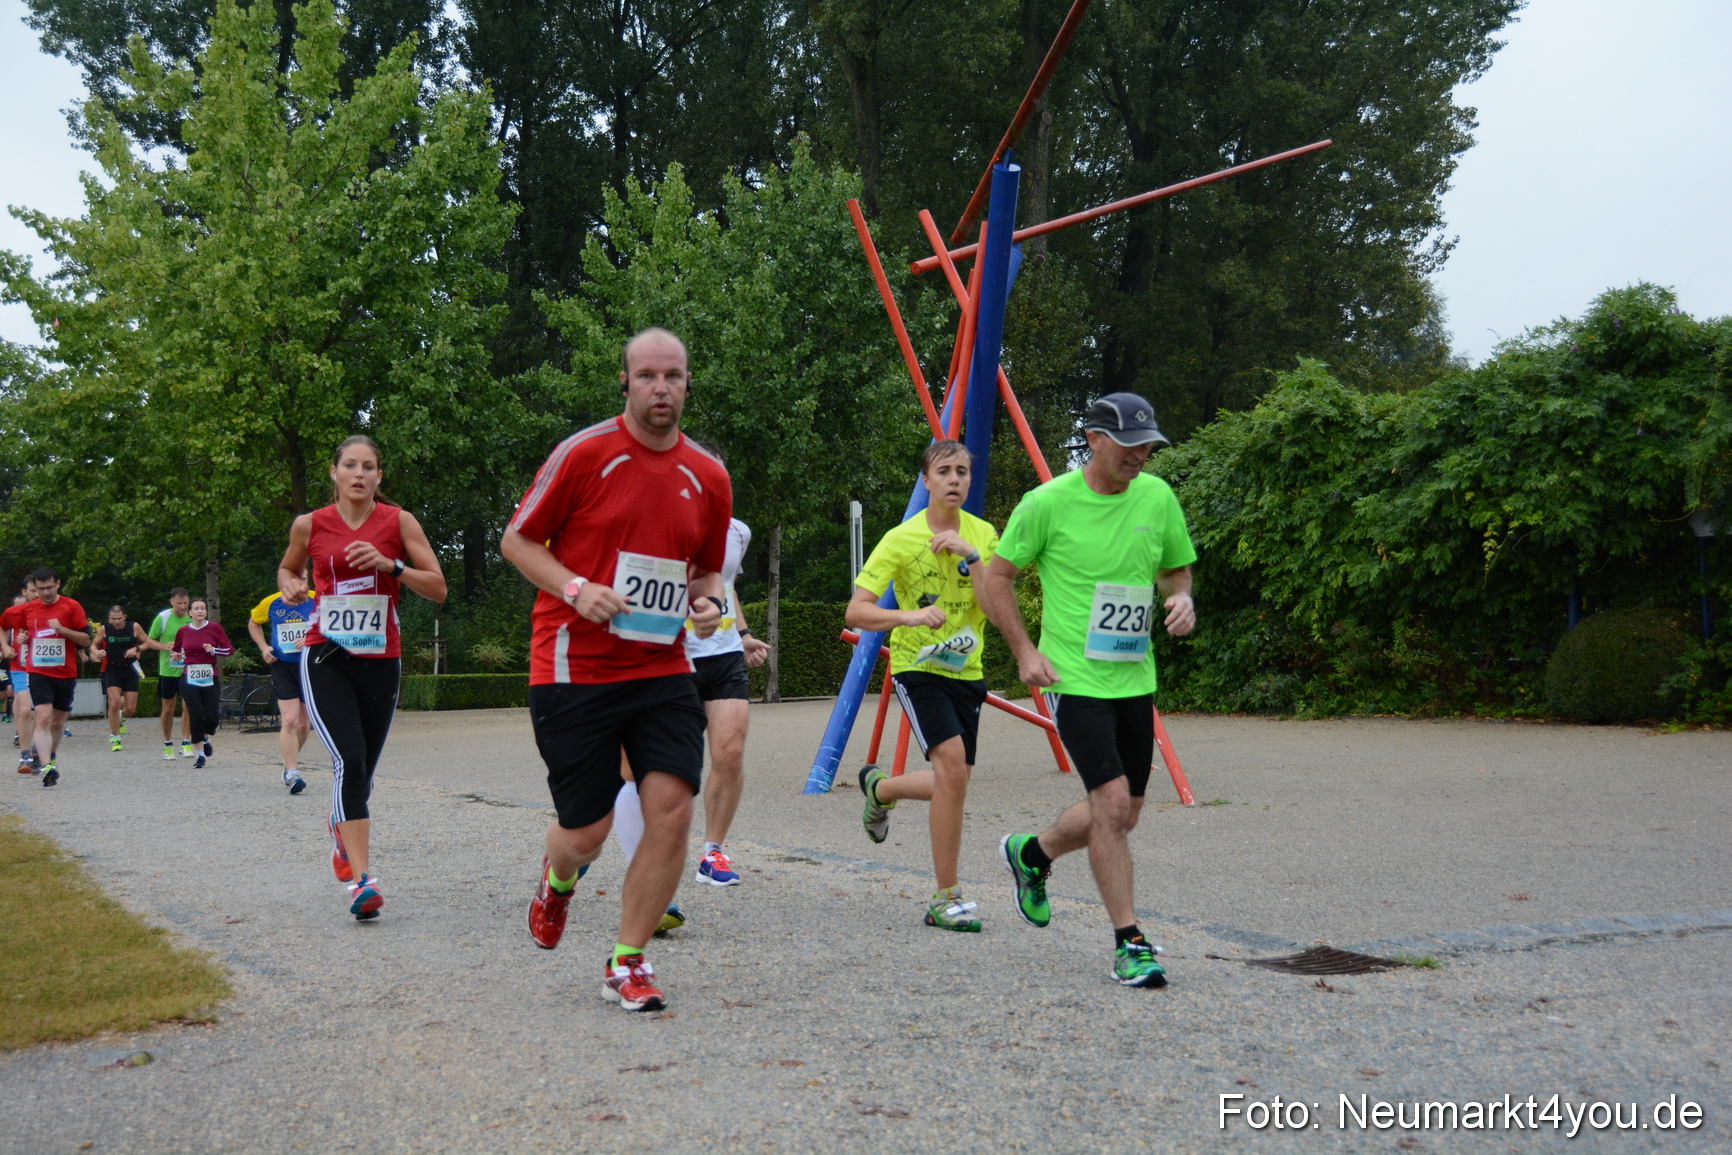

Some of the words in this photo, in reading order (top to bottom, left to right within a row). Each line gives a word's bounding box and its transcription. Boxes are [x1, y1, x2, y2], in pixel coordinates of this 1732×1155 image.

[625, 575, 687, 612] 2007
[328, 609, 382, 631] 2074
[1098, 602, 1152, 632] 2230
[352, 636, 381, 647] Sophie
[1113, 638, 1138, 651] Josef
[35, 645, 63, 656] 2263
[190, 669, 212, 679] 2302
